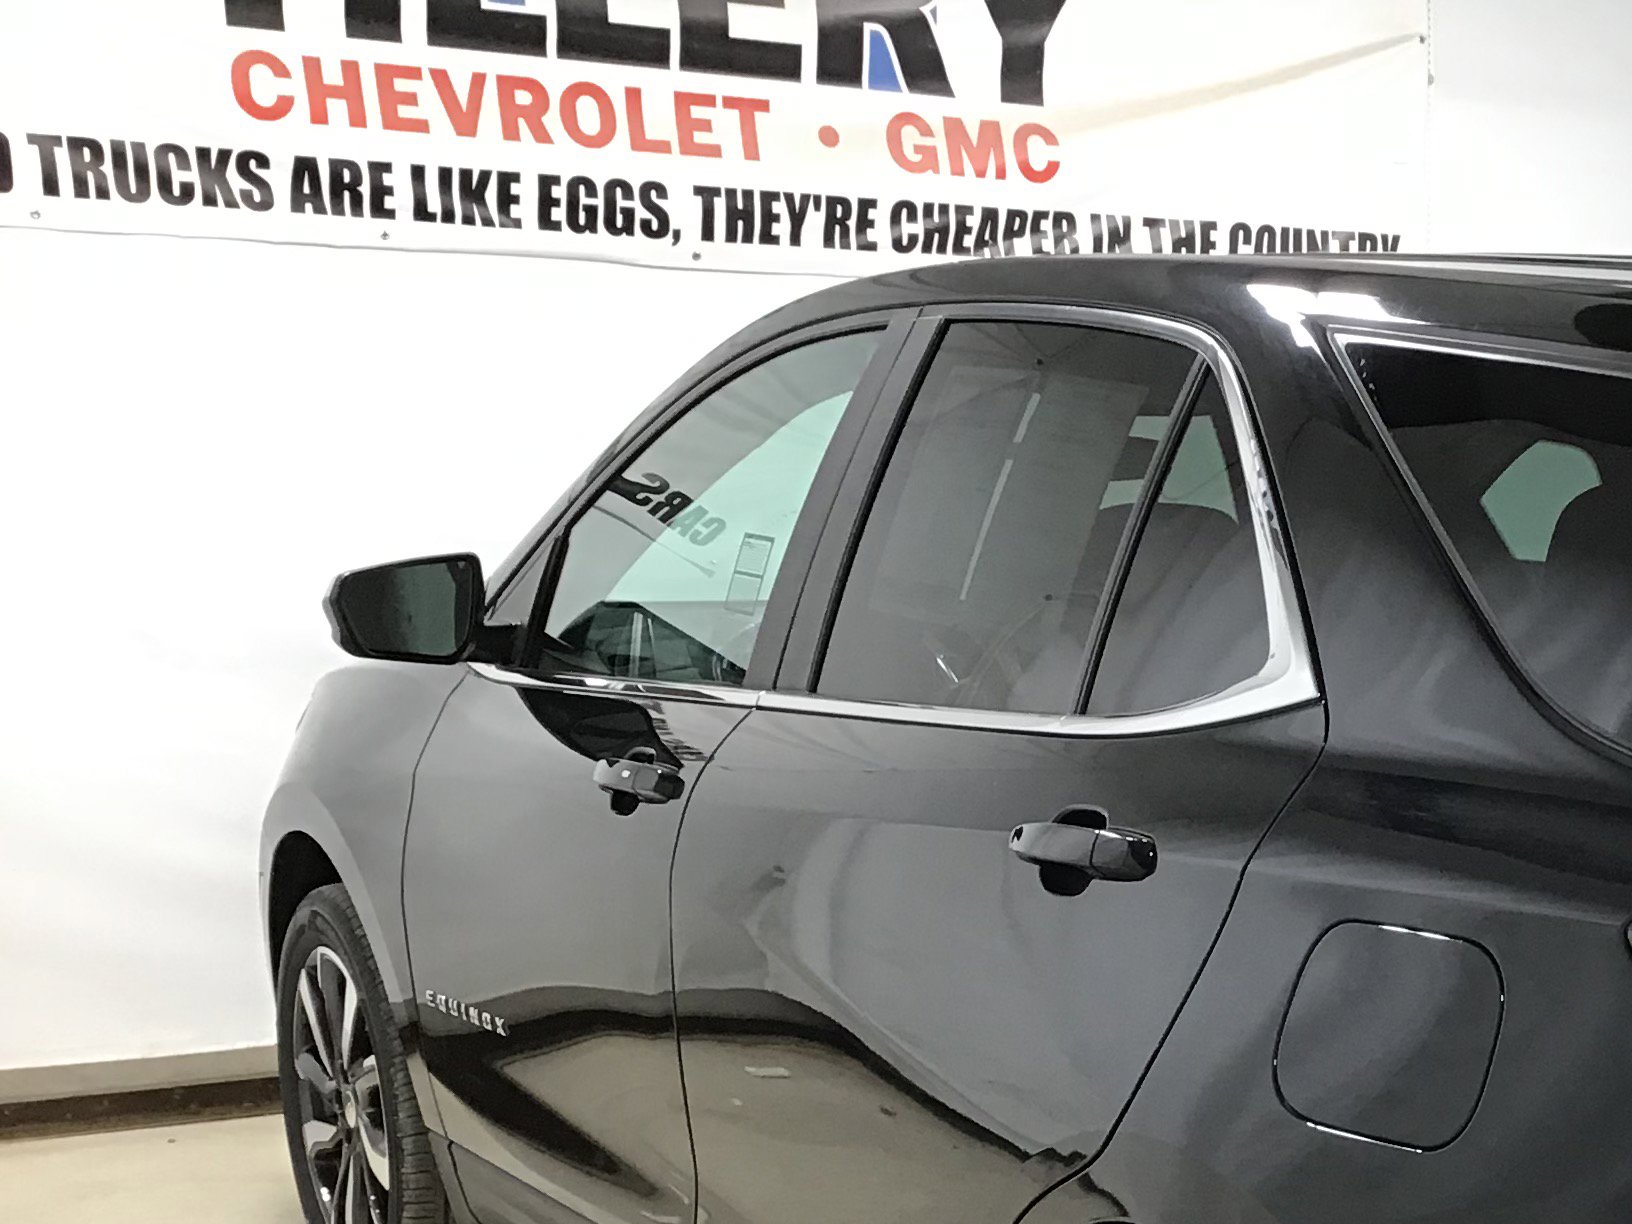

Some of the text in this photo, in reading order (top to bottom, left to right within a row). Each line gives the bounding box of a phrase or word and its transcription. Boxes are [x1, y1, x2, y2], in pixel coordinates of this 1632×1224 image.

[231, 49, 770, 162] CHEVROLET
[886, 111, 1061, 184] GMC
[26, 133, 274, 212] TRUCKS
[290, 155, 396, 220] ARE
[410, 164, 522, 229] LIKE
[537, 173, 682, 246] EGGS,
[693, 185, 878, 252] THEY'RE
[889, 199, 1080, 257] CHEAPER
[1090, 213, 1133, 254] IN
[1143, 217, 1217, 254] THE
[426, 989, 507, 1037] EQUINOX
